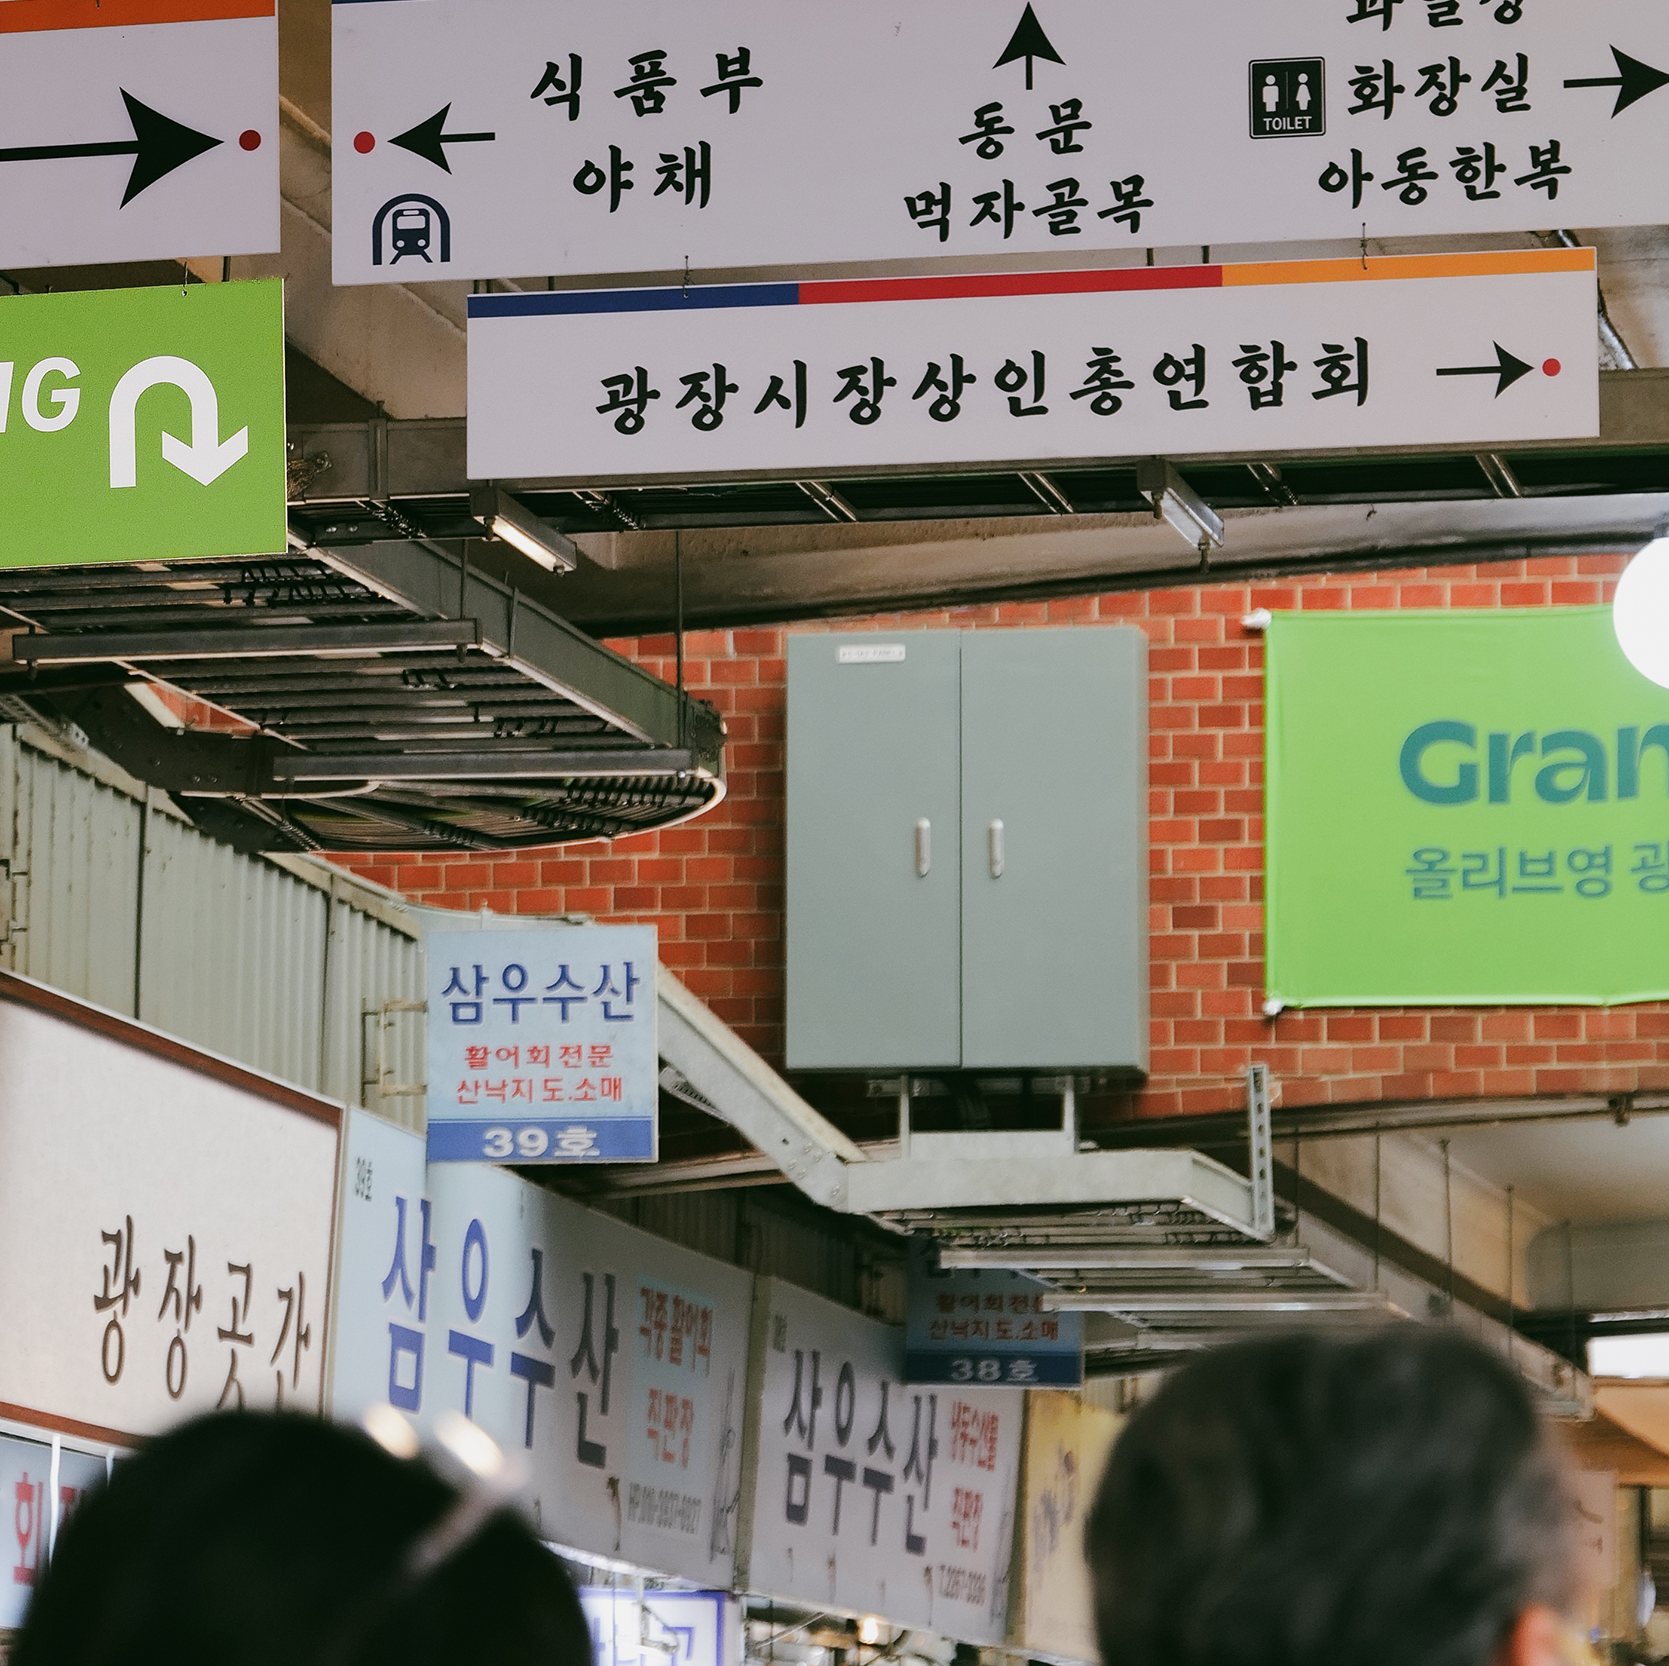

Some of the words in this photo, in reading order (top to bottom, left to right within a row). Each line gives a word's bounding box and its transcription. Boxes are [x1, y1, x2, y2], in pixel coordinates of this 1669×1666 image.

[530, 47, 763, 122] 식품부
[1347, 53, 1533, 120] 화장실
[958, 97, 1093, 161] 동문
[1262, 114, 1312, 132] TOILET
[572, 140, 713, 213] 야채
[1318, 139, 1572, 209] 아동한복
[903, 174, 1155, 243] 먹자골목
[595, 336, 1369, 435] 광장시장상인총연합회
[1399, 719, 1669, 806] Gran
[1405, 844, 1614, 901] 올리브영
[441, 961, 641, 1025] 삼우수산
[456, 1076, 533, 1105] 산낙지
[484, 1125, 601, 1159] 39호
[381, 1195, 619, 1468] 삼우수산
[950, 1357, 1040, 1382] 38호
[783, 1348, 939, 1557] 삼우수산
